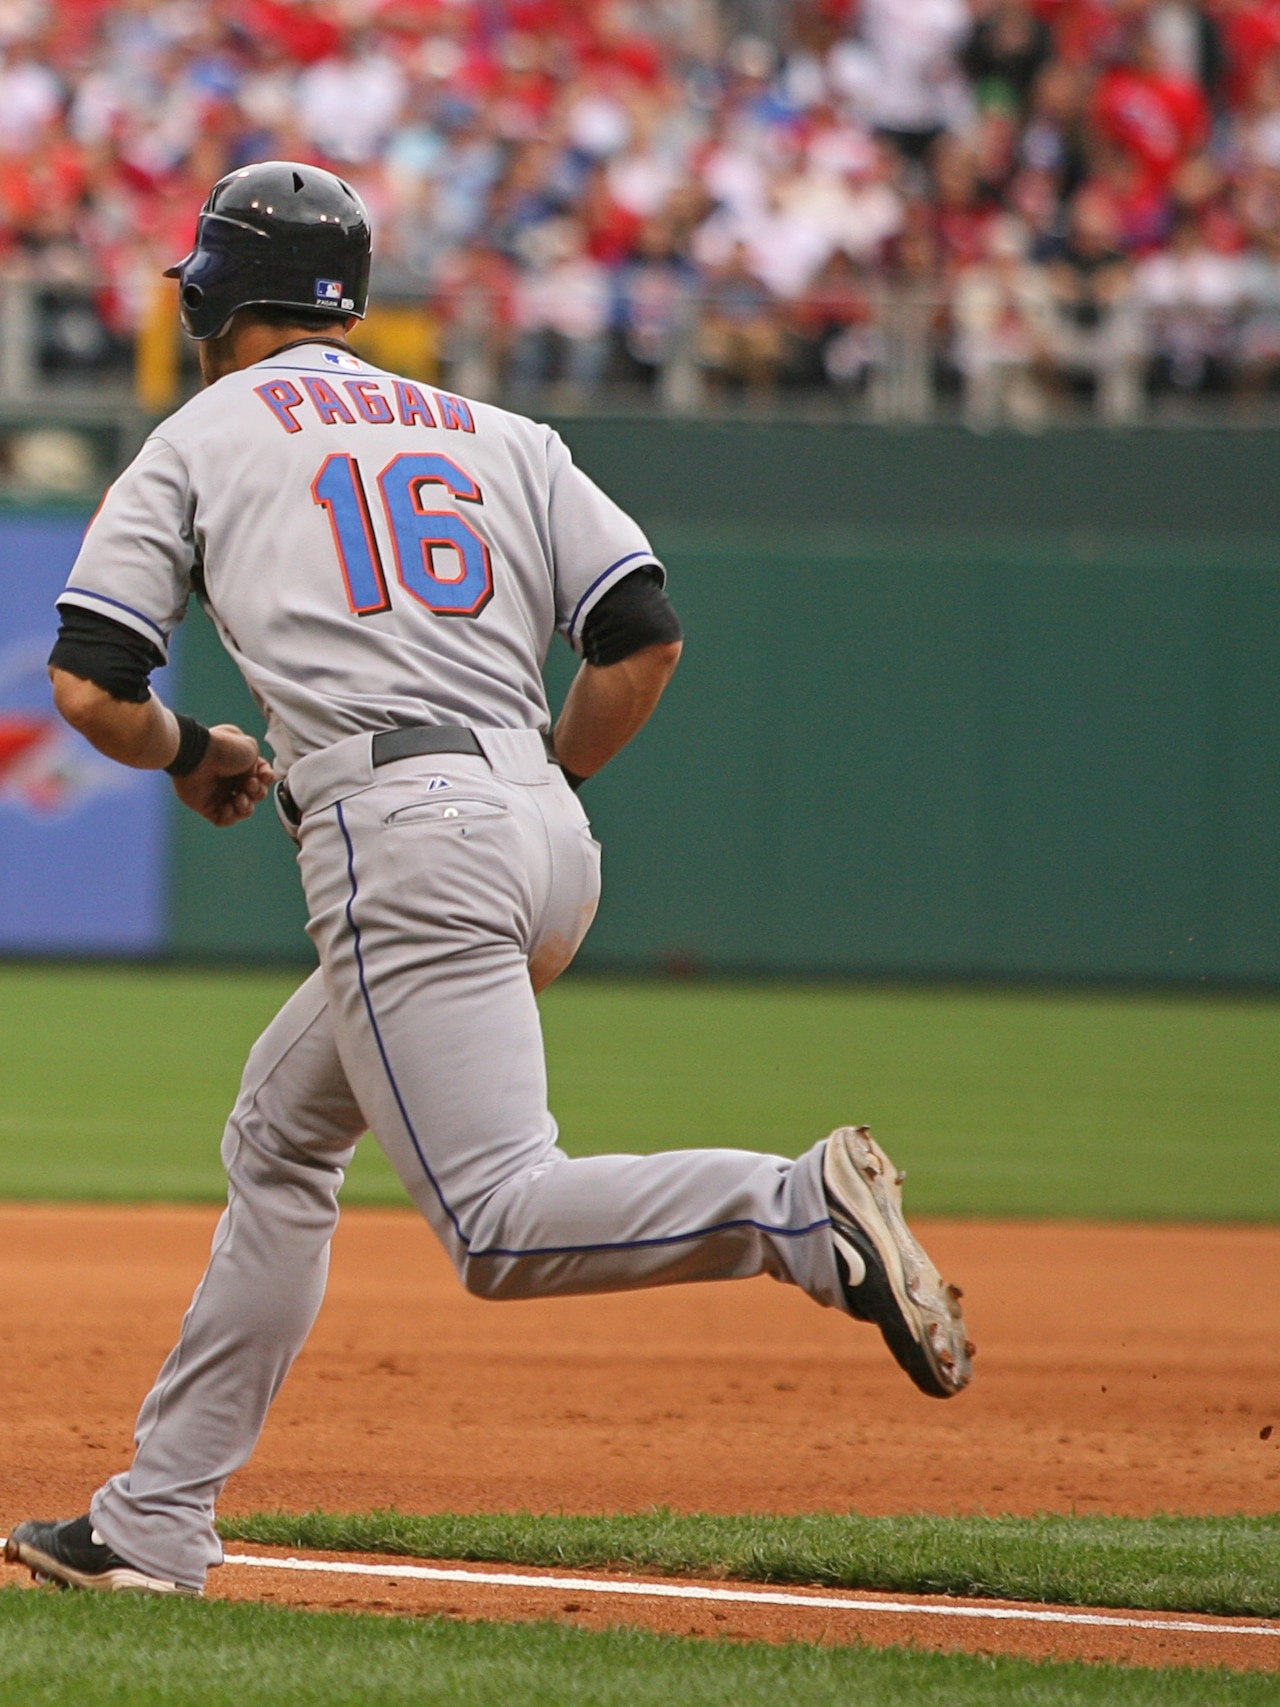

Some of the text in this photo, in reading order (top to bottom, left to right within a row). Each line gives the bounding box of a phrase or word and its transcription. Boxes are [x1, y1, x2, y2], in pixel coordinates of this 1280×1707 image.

[317, 299, 338, 307] PAGAN
[253, 376, 476, 434] PAGAN
[310, 452, 495, 619] 16
